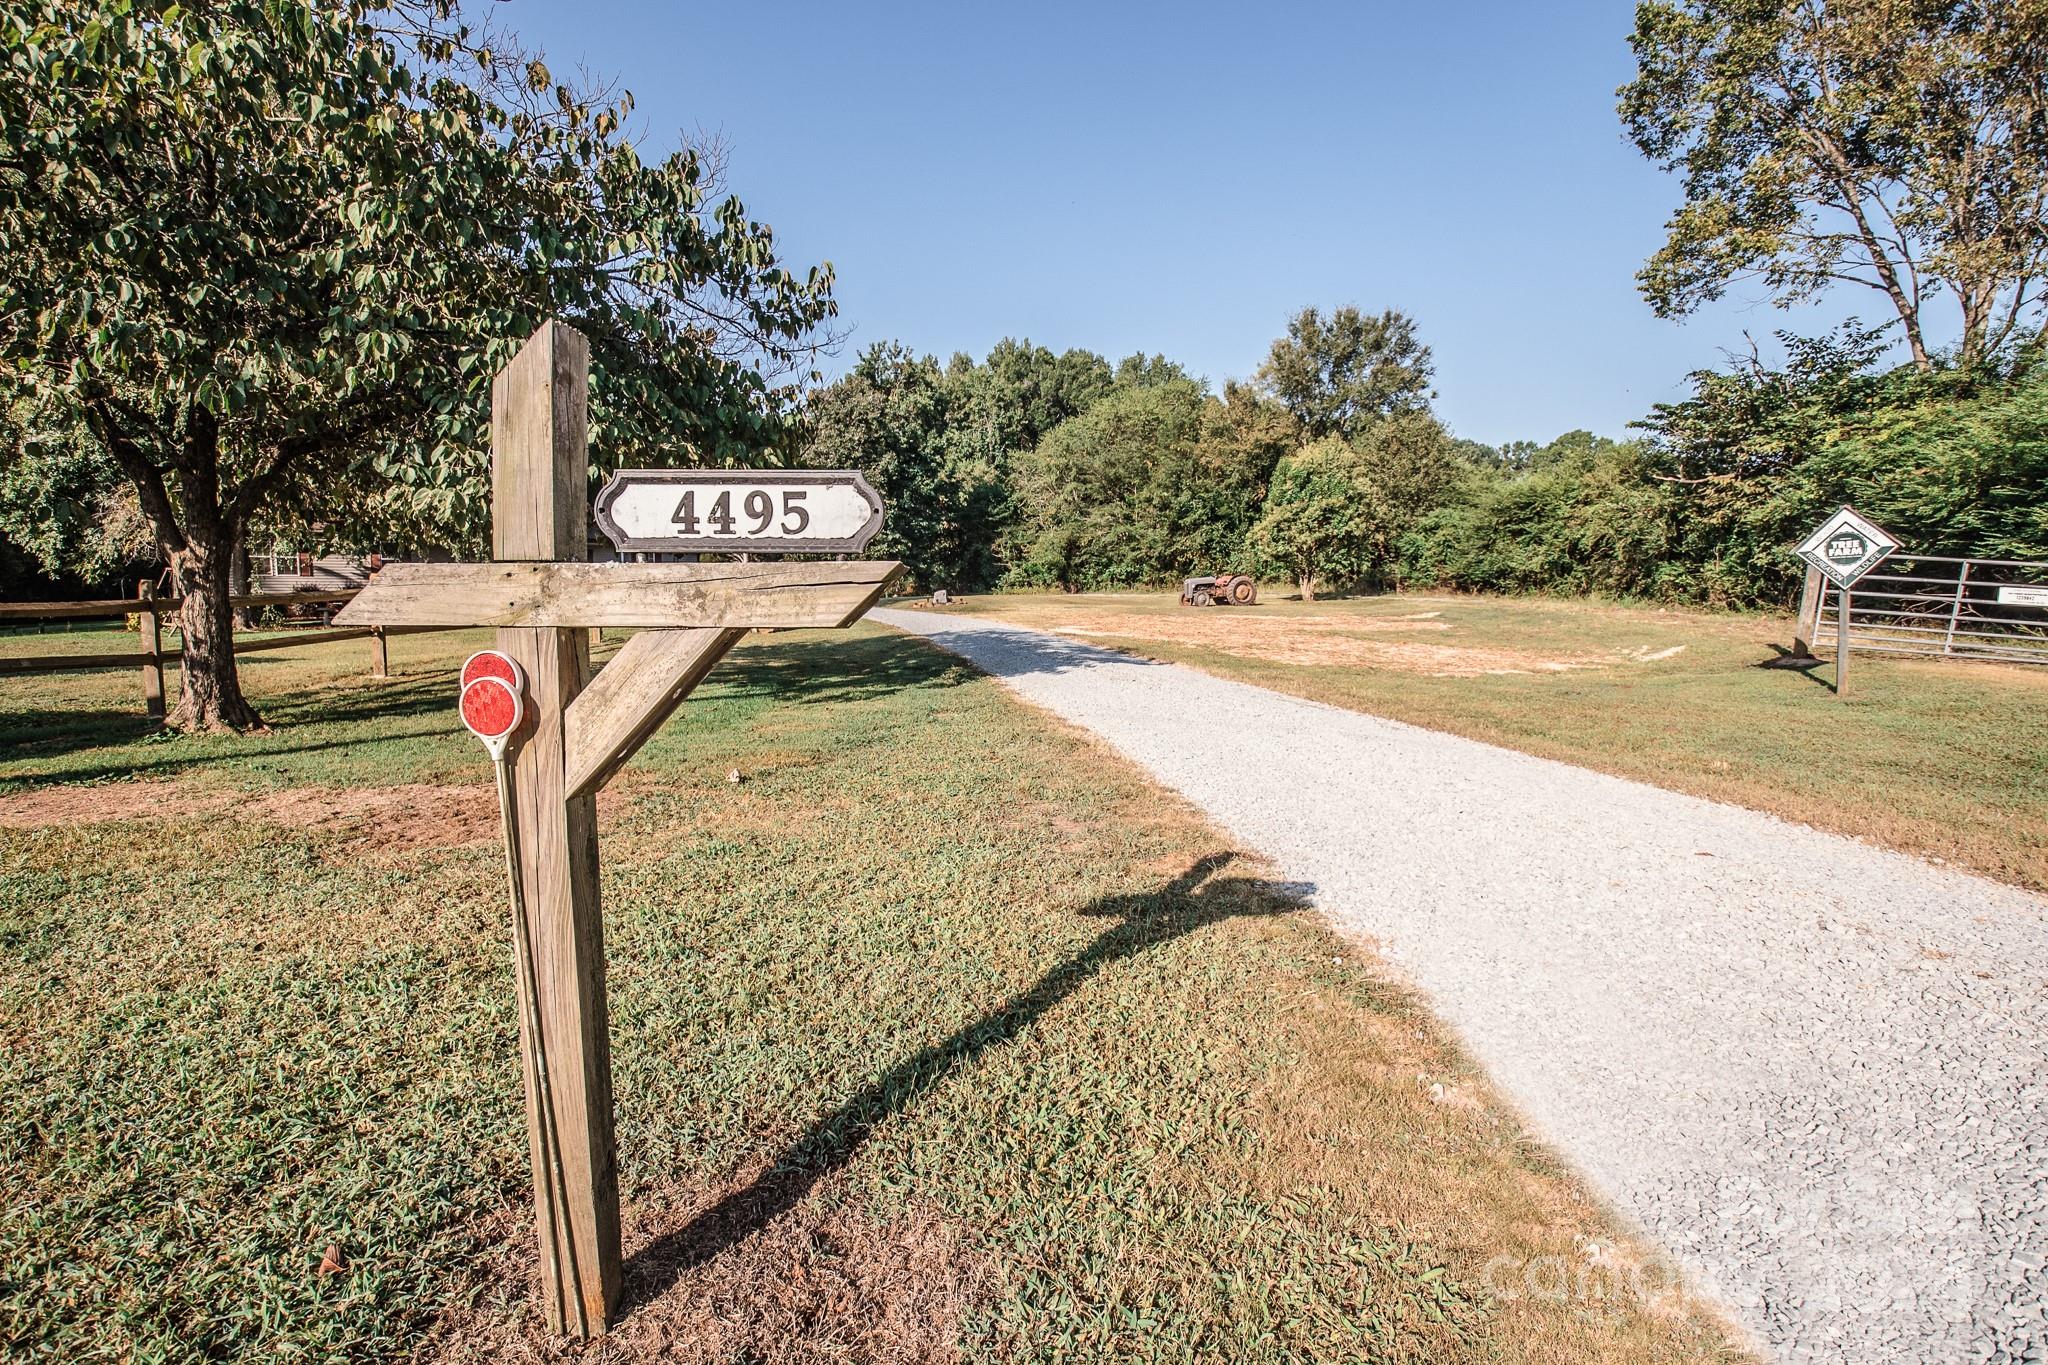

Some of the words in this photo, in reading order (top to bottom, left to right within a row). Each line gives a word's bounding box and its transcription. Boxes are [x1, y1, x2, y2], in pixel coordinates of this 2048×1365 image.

[671, 490, 810, 535] 4495
[1828, 547, 1863, 557] FARM
[1831, 540, 1860, 549] TREE
[1806, 552, 1843, 581] RECREATION
[1852, 552, 1882, 576] WILDLIFE
